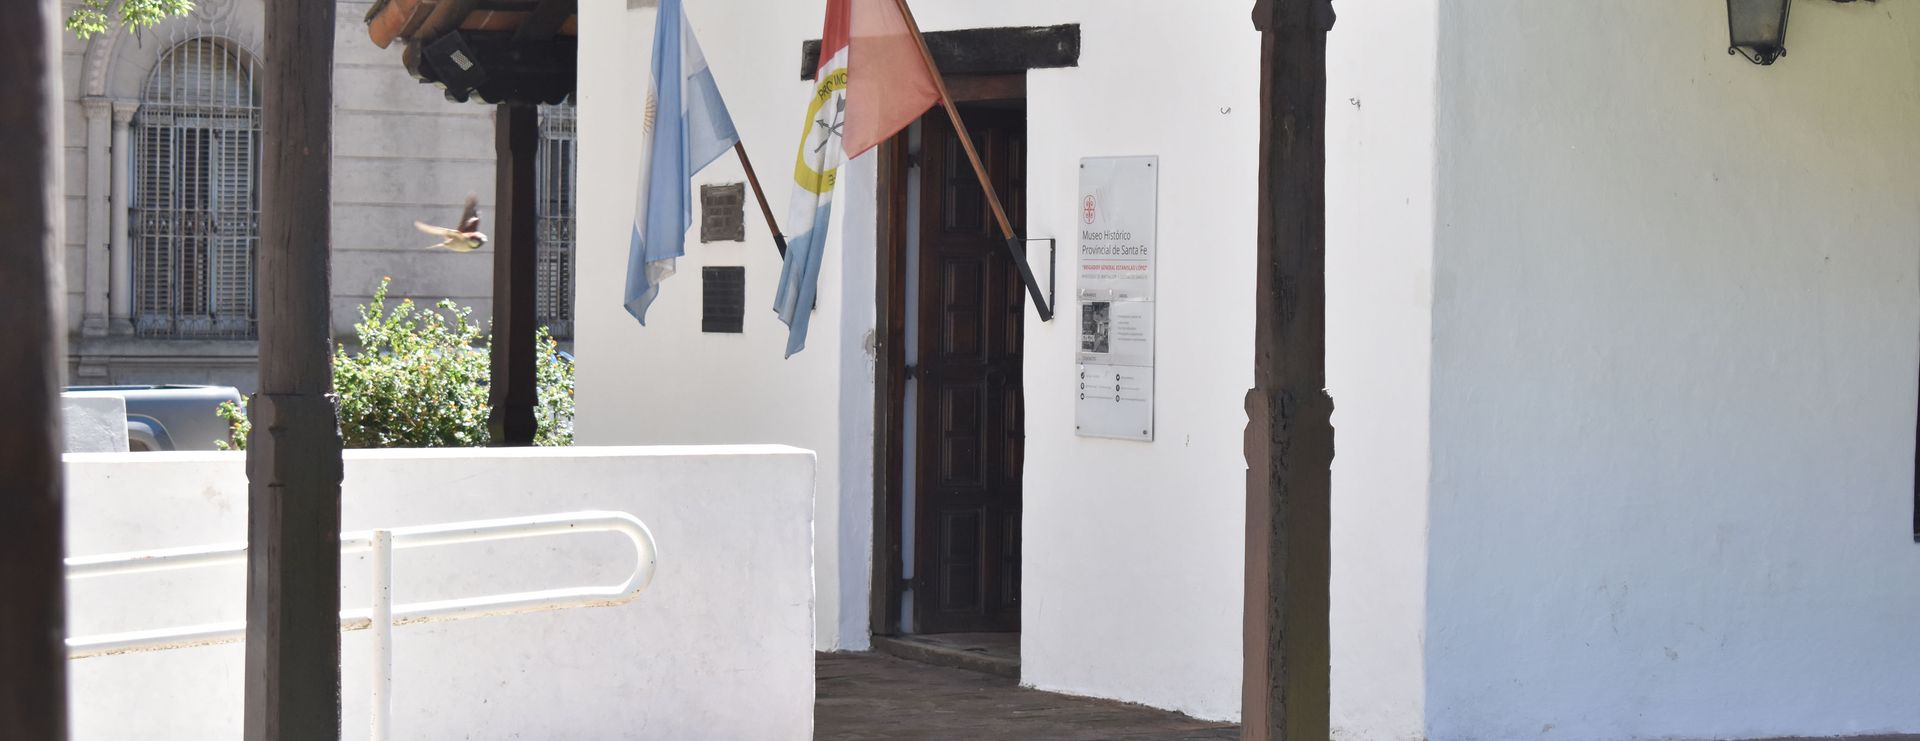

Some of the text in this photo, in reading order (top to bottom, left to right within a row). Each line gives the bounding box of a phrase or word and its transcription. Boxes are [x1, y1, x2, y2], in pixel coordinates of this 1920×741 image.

[1082, 230, 1131, 240] Museo Histórico
[1082, 244, 1148, 255] Provincial de Santa Fe
